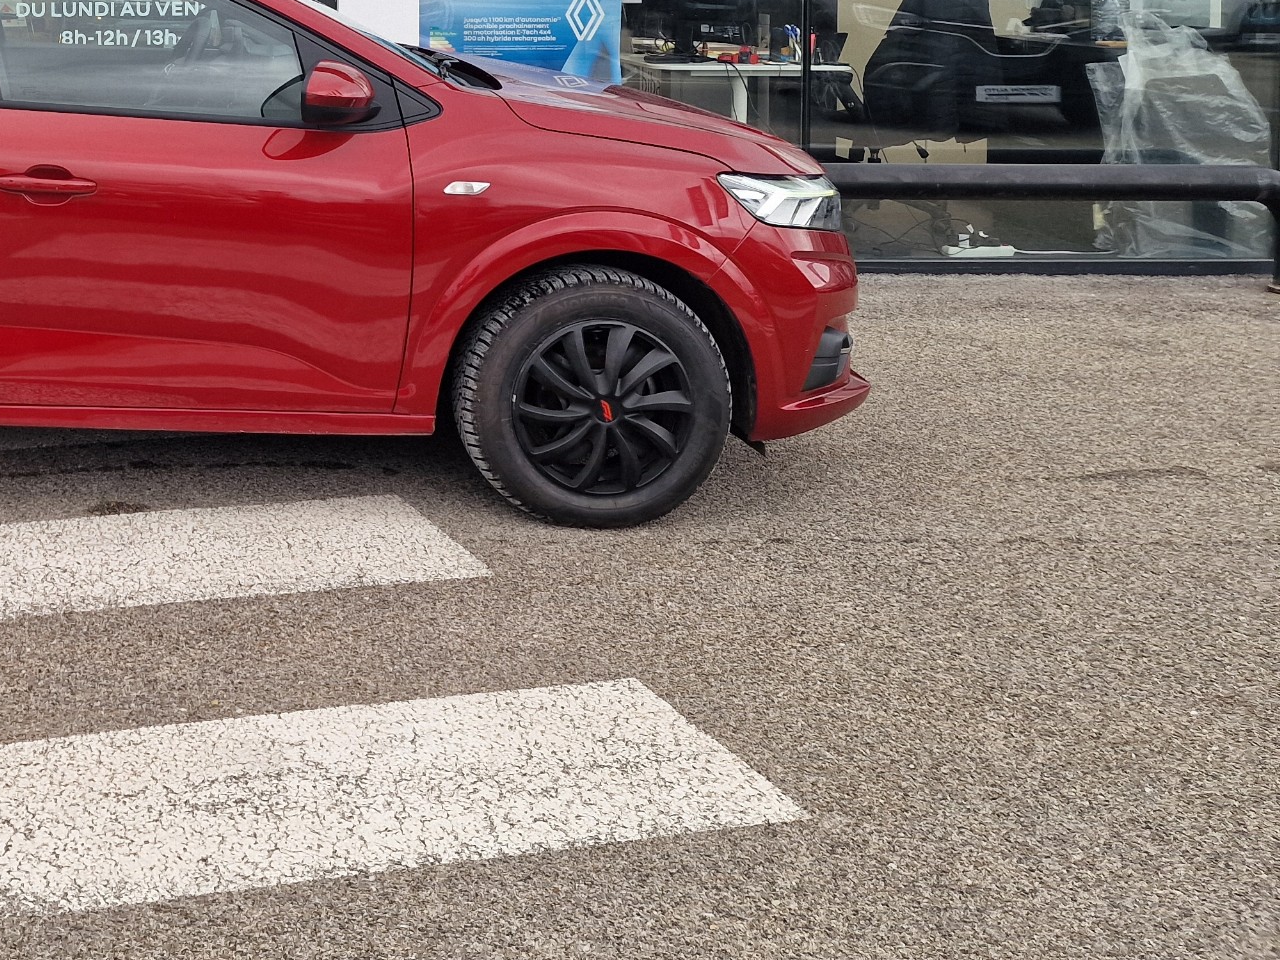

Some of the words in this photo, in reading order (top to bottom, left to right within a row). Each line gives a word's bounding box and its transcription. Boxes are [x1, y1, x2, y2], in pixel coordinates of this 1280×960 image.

[15, 1, 46, 18] DU
[51, 1, 115, 18] LUNDI
[120, 1, 151, 17] AU
[157, 0, 206, 17] VEN
[61, 30, 128, 46] 8h-12h
